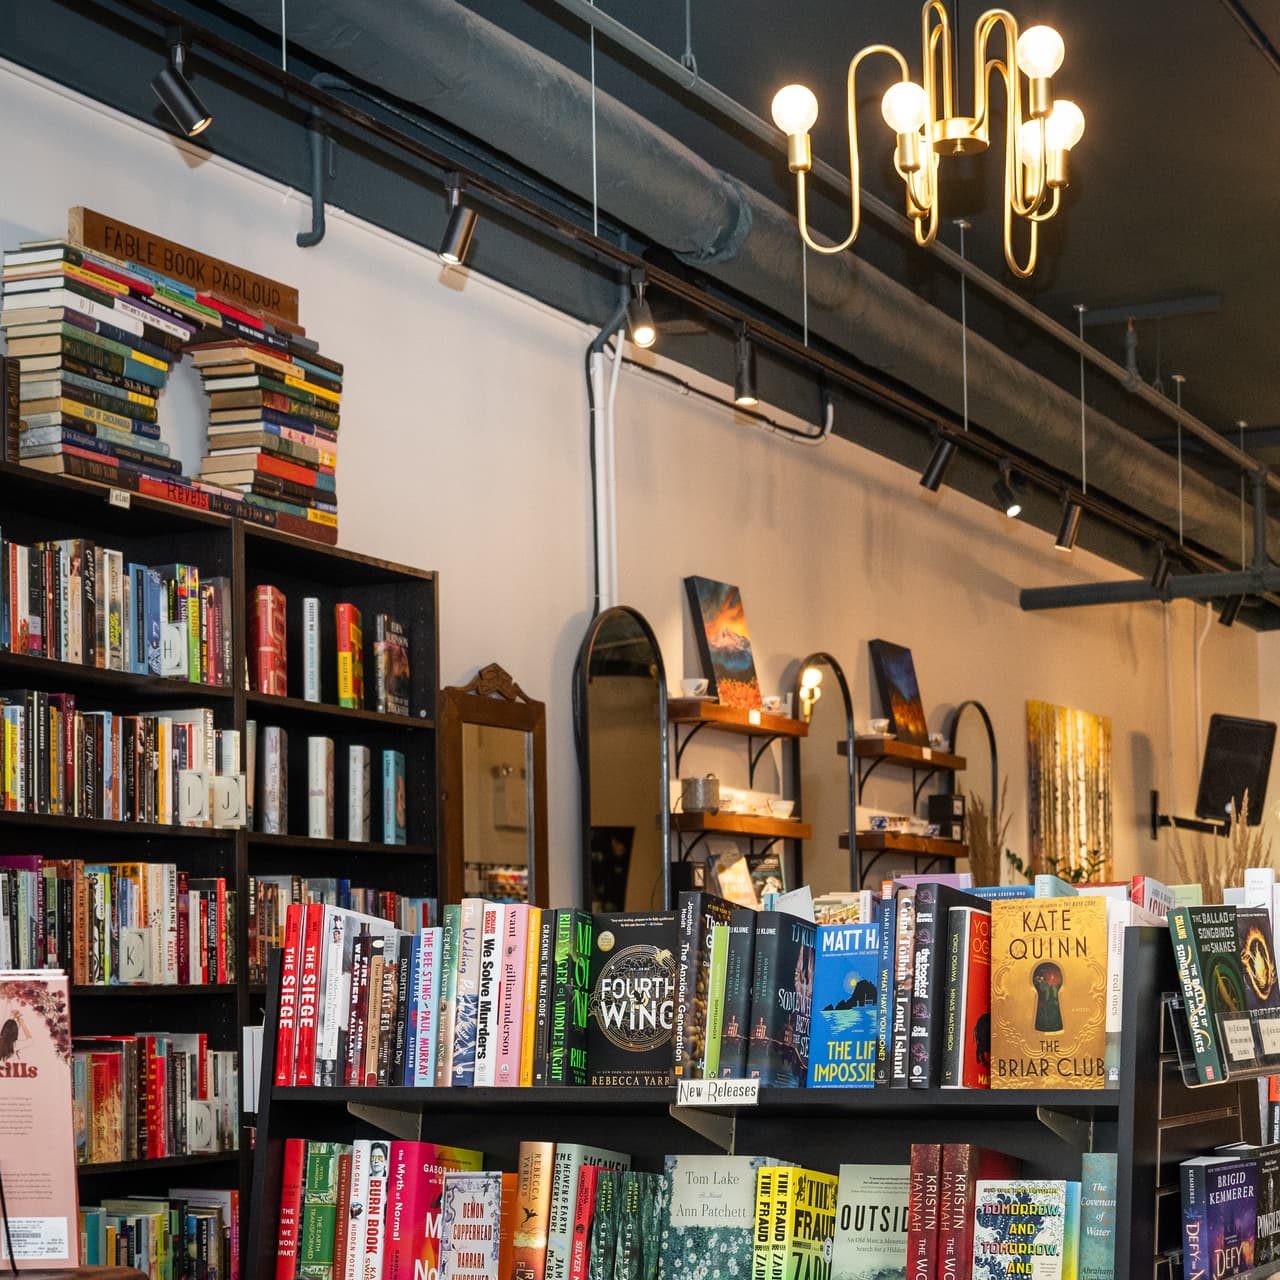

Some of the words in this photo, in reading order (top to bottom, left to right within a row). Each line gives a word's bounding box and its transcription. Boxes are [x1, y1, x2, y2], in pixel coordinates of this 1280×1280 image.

[104, 226, 157, 266] FABLE
[164, 247, 204, 282] BOOK
[212, 267, 281, 309] PARLOUR
[1023, 910, 1071, 931] KATE
[1192, 914, 1201, 922] THE
[1202, 913, 1227, 924] BALLAD
[1229, 912, 1237, 921] OF
[424, 930, 433, 949] THE
[541, 925, 550, 960] CRACKING
[823, 929, 862, 953] MATT
[1198, 928, 1236, 938] SONGBIRDS
[126, 947, 135, 965] K
[306, 946, 315, 972] THE
[423, 950, 432, 968] BEE
[484, 937, 495, 958] We
[680, 944, 689, 962] The
[1009, 937, 1088, 960] QUINN
[285, 948, 295, 973] THE
[352, 943, 361, 1005] WEATHER
[422, 970, 432, 1000] STING
[481, 960, 494, 997] Solve
[678, 964, 689, 1003] Anxious
[601, 977, 675, 999] FOURTH
[279, 976, 295, 1029] SIEGE
[300, 974, 315, 1028] SIEGE
[420, 1010, 431, 1034] PAUL
[602, 1001, 673, 1030] WING
[895, 997, 907, 1032] Long
[477, 1001, 491, 1060] Murders
[675, 1005, 686, 1062] Generation
[419, 1037, 429, 1076] MURRAY
[894, 1036, 905, 1077] Island
[1040, 1040, 1060, 1053] THE
[998, 1058, 1051, 1077] BRIAR
[1057, 1058, 1105, 1077] CLUB
[592, 1076, 640, 1087] REBECCA
[679, 1082, 703, 1102] New
[708, 1083, 757, 1102] Releases
[685, 1171, 709, 1186] Tom
[713, 1172, 739, 1186] Lake
[759, 1173, 771, 1197] THE
[1218, 1172, 1246, 1188] BRIGID
[369, 1179, 382, 1216] BURN
[912, 1173, 923, 1231] HANNAH
[925, 1175, 936, 1230] KRISTIN
[1209, 1186, 1255, 1205] KEMMERER
[463, 1202, 484, 1217] DEMON
[676, 1204, 698, 1217] Ann
[702, 1203, 747, 1217] Patchett
[983, 1203, 1061, 1217] TOMORROW,
[453, 1223, 492, 1241] COPPERHEAD
[757, 1201, 770, 1242] FRAUD
[1009, 1223, 1035, 1235] AND
[366, 1219, 380, 1256] BOOK
[981, 1242, 1059, 1256] TOMORROW,
[1186, 1223, 1200, 1256] DEFY
[457, 1252, 486, 1269] BARBARA
[1007, 1263, 1033, 1275] AND
